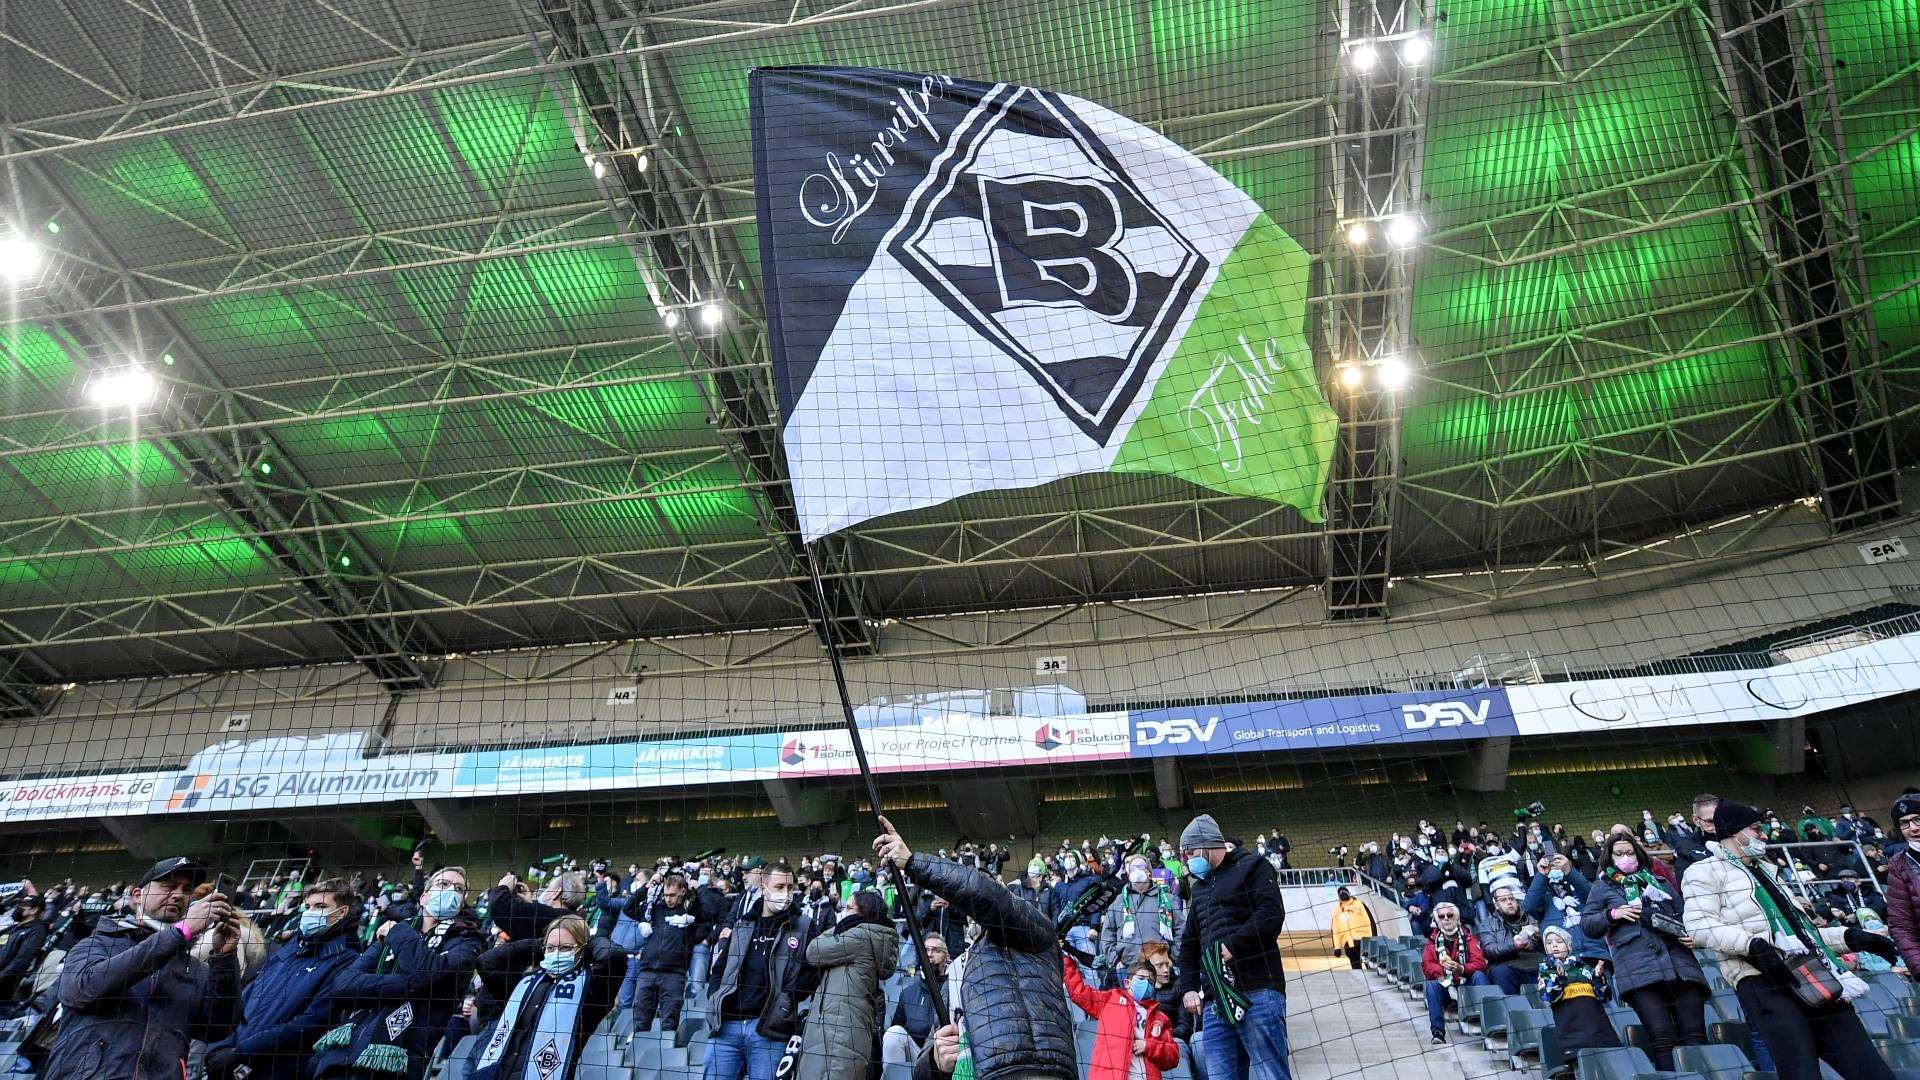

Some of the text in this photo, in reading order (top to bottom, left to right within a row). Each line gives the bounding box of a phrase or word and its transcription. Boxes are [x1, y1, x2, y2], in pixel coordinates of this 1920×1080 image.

[1870, 544, 1896, 557] 2A
[1043, 661, 1060, 670] 3A
[1401, 699, 1491, 730] DSV
[1077, 730, 1130, 744] solution
[1135, 716, 1219, 746] DSV
[1233, 722, 1381, 741] Global Transport and Logistics
[881, 734, 1024, 753] Your Project Partner
[819, 749, 870, 759] solutin
[209, 768, 439, 798] ASG Aluminium
